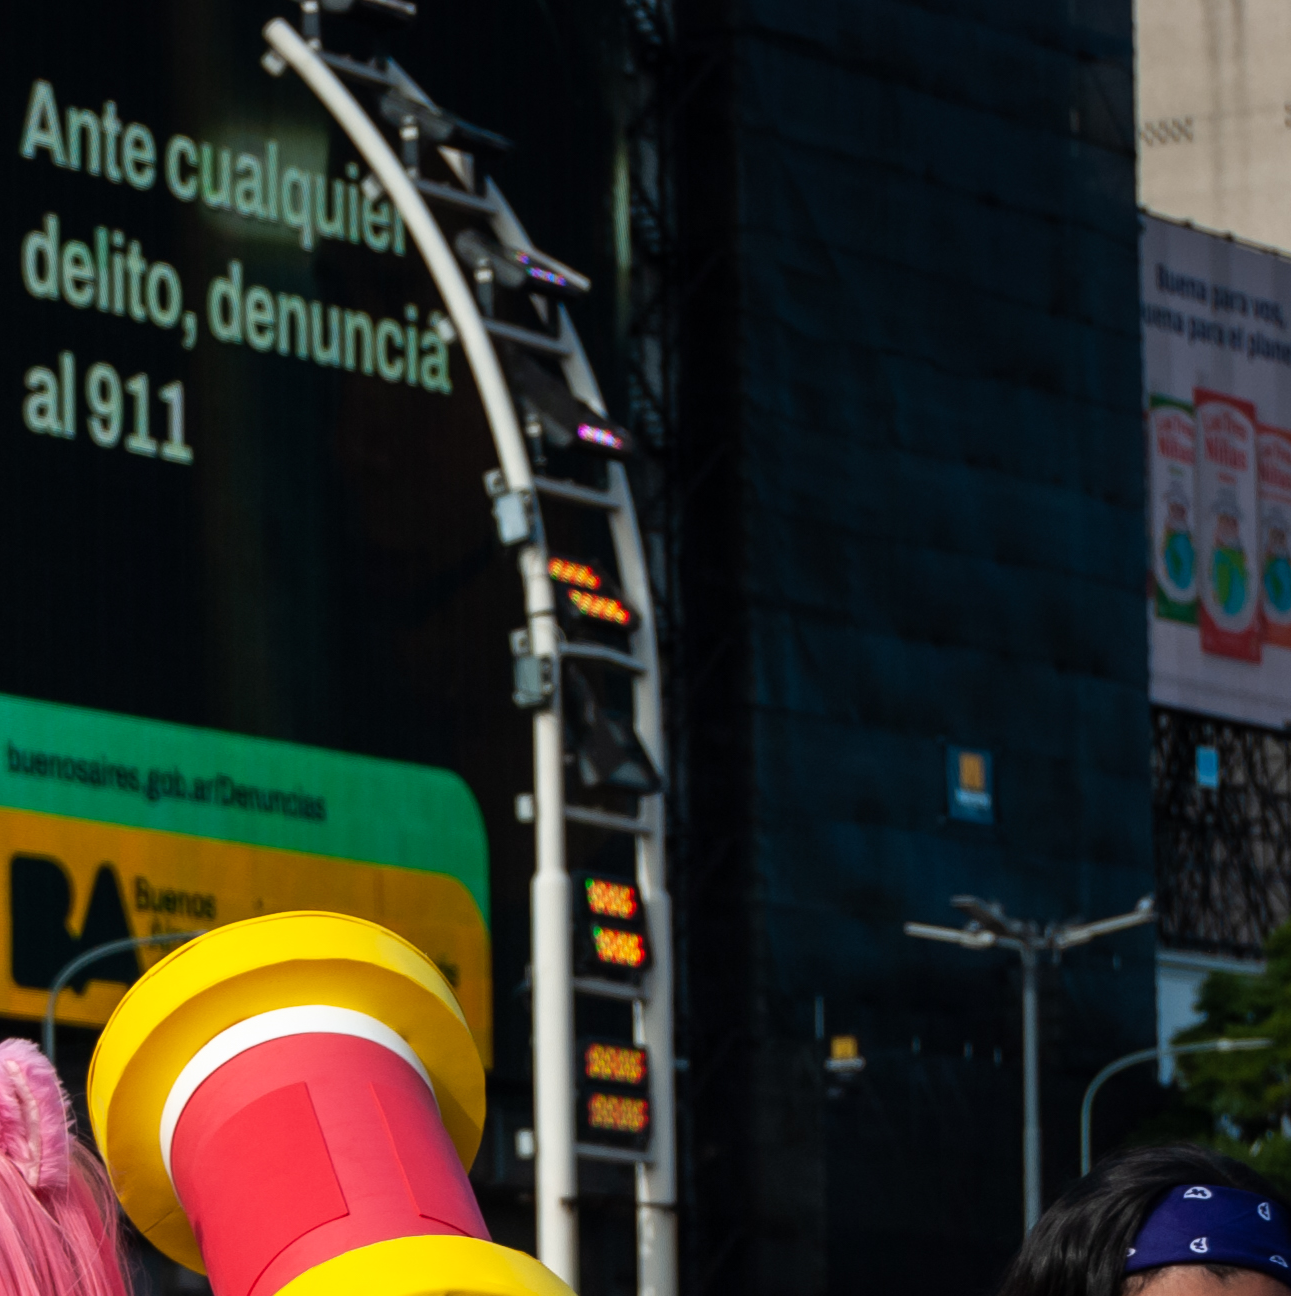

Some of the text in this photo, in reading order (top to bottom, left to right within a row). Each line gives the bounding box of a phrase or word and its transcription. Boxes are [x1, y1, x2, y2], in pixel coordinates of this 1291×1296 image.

[21, 79, 157, 189] Ante
[21, 212, 197, 350] delito,
[23, 350, 195, 465] al 911
[134, 874, 216, 921] Buenos
